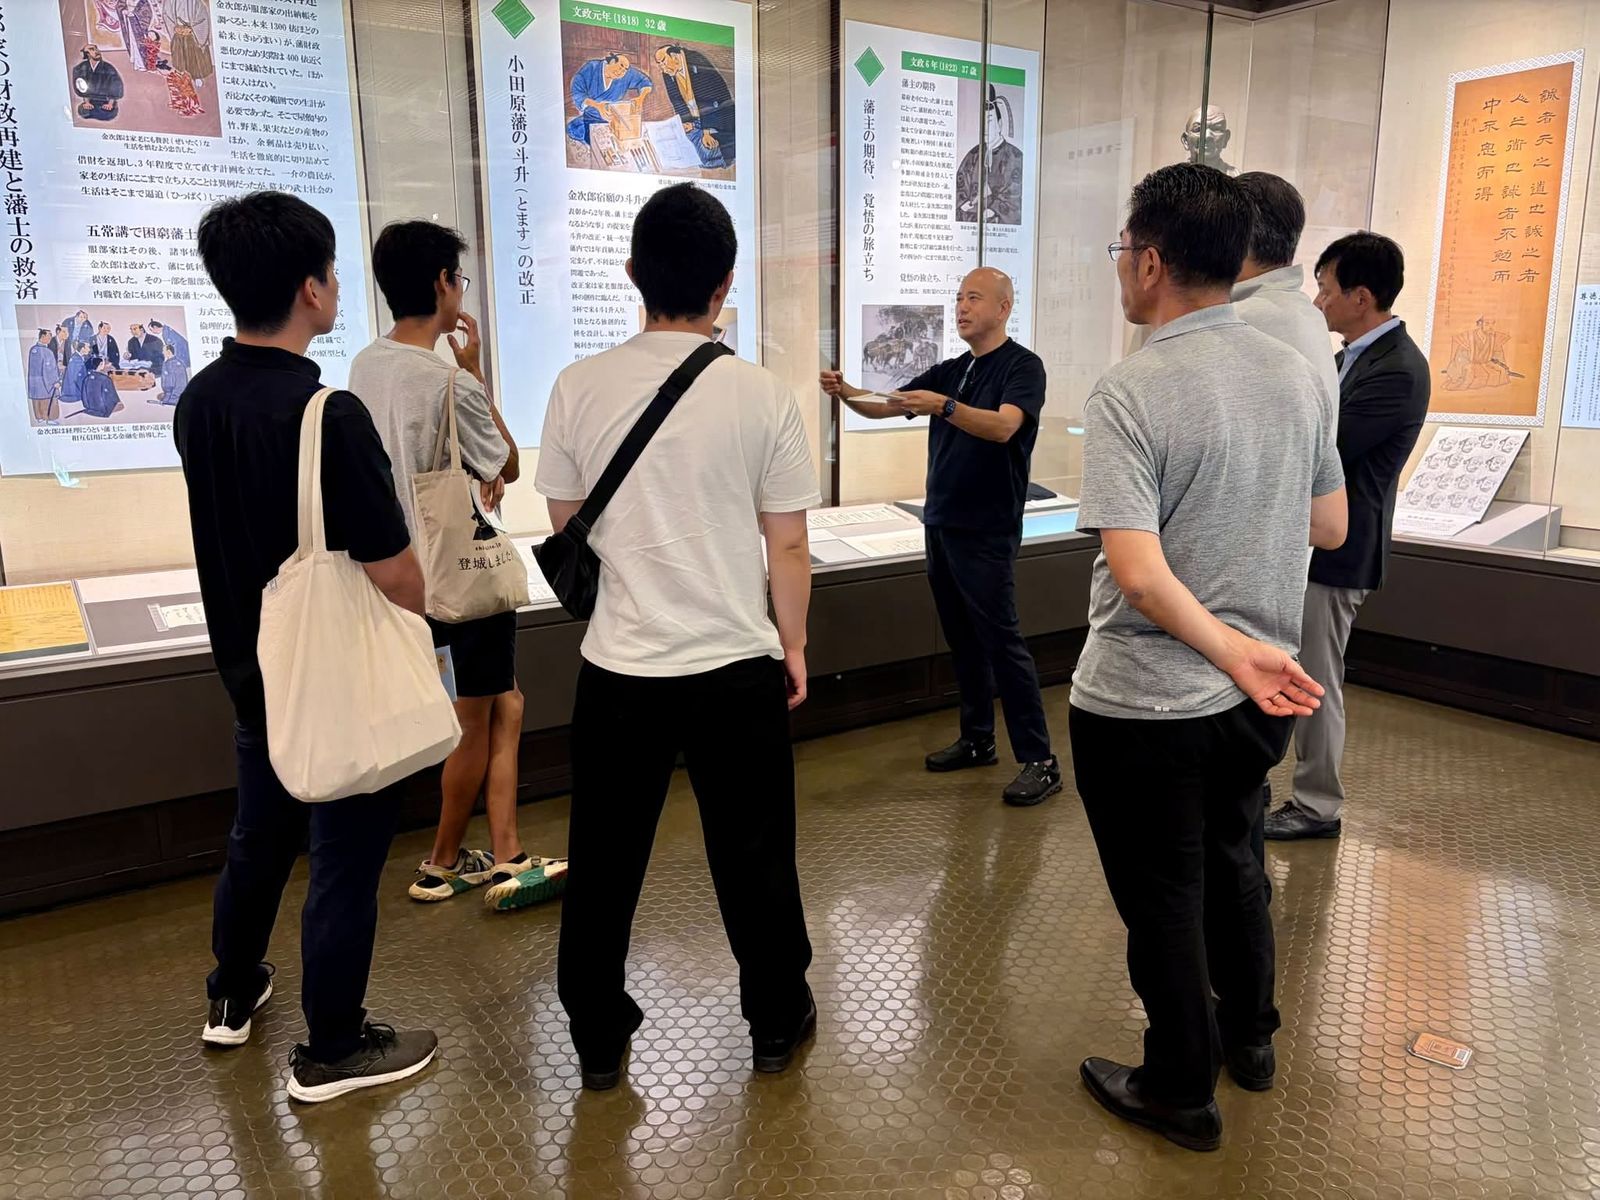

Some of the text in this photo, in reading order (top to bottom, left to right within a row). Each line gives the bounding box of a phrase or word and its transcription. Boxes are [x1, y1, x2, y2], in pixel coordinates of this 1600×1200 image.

[0, 6, 39, 299] 財政再建と藩士の救済
